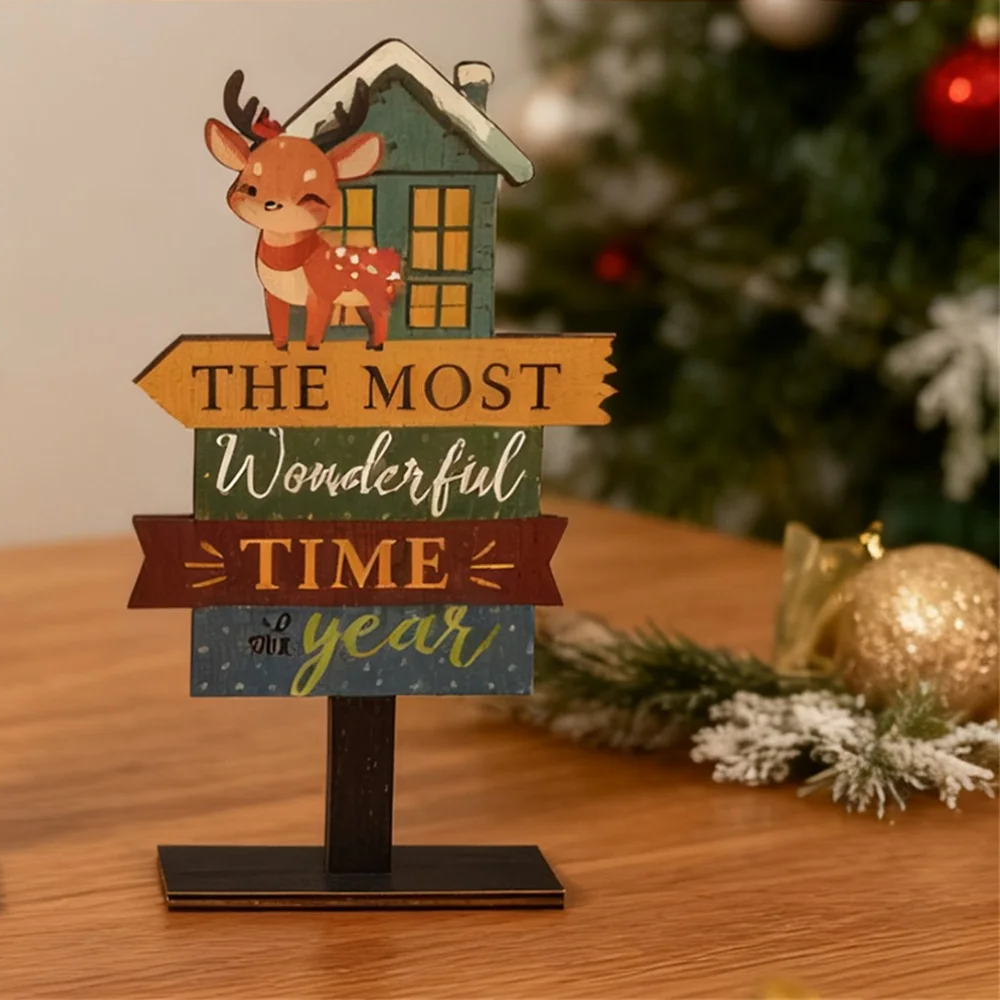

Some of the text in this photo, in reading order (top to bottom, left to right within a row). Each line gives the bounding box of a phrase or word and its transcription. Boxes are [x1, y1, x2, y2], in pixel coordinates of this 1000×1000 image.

[192, 363, 562, 412] THE MOST
[215, 426, 527, 517] Wonderful
[239, 537, 449, 591] TIME
[290, 604, 501, 697] year
